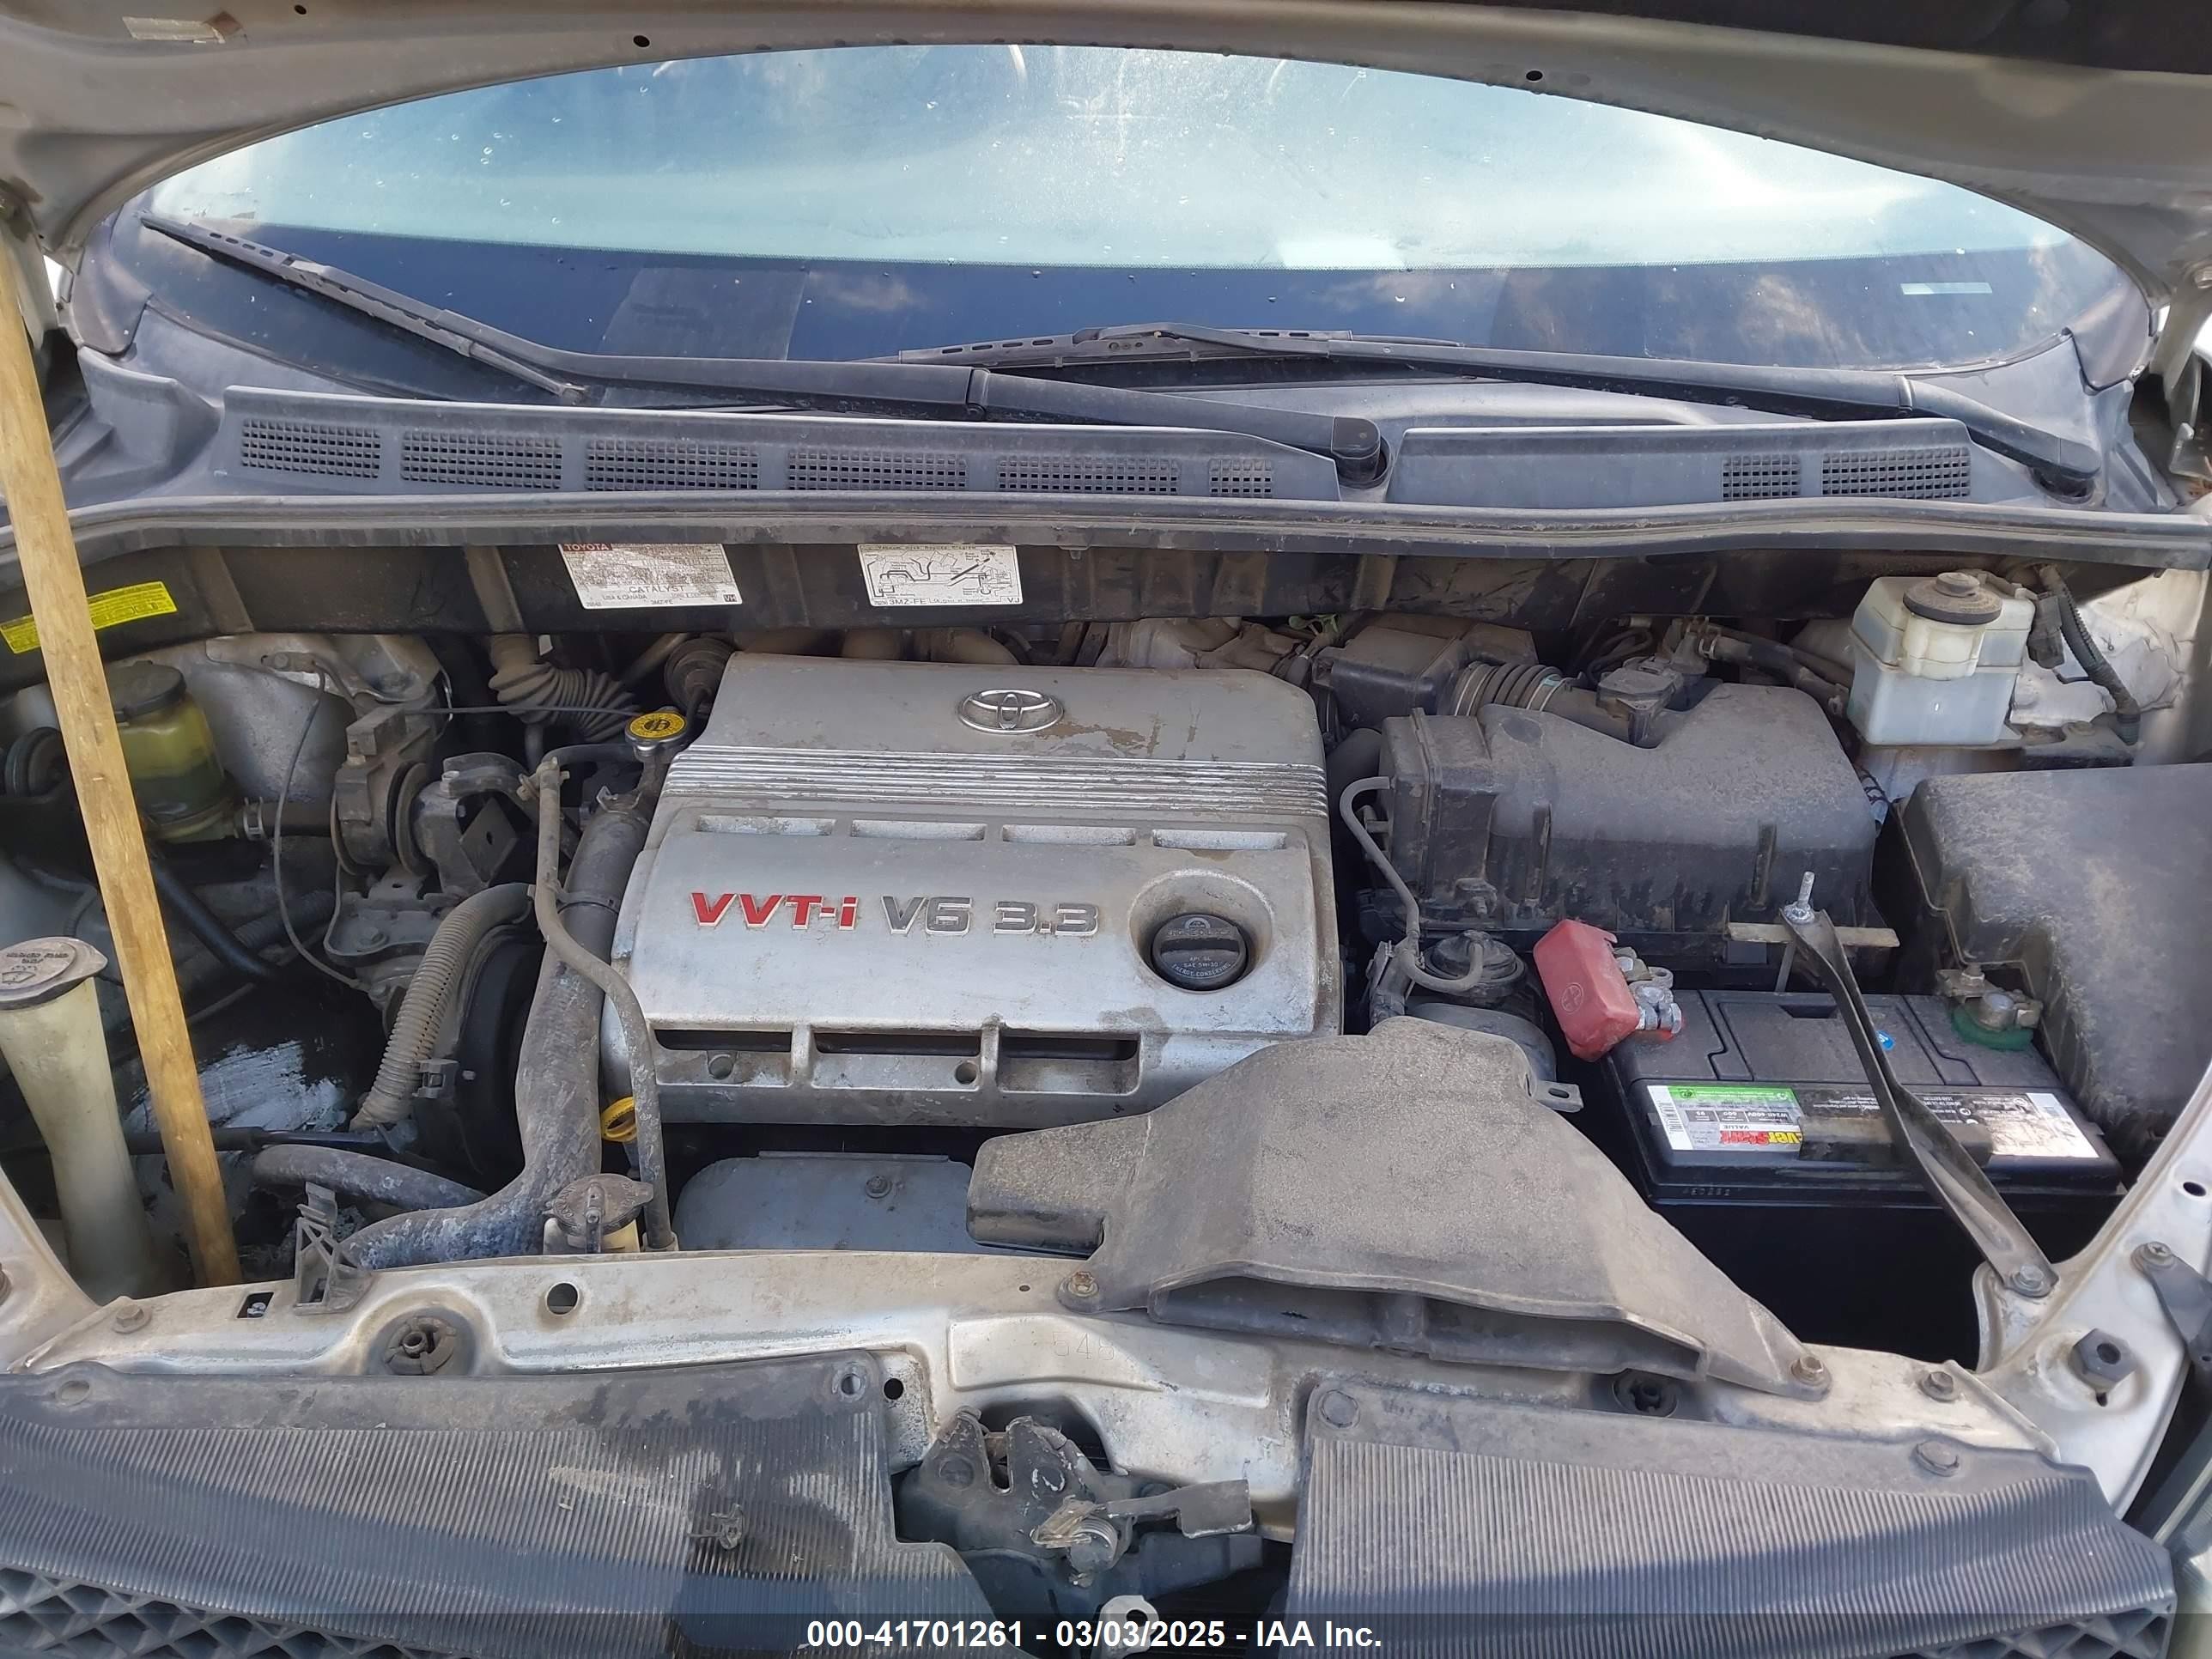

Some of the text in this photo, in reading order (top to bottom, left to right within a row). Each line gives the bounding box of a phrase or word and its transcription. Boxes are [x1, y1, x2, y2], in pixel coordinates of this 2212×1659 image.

[690, 892, 860, 930] VVT-i
[881, 896, 1099, 937] V6 3.3
